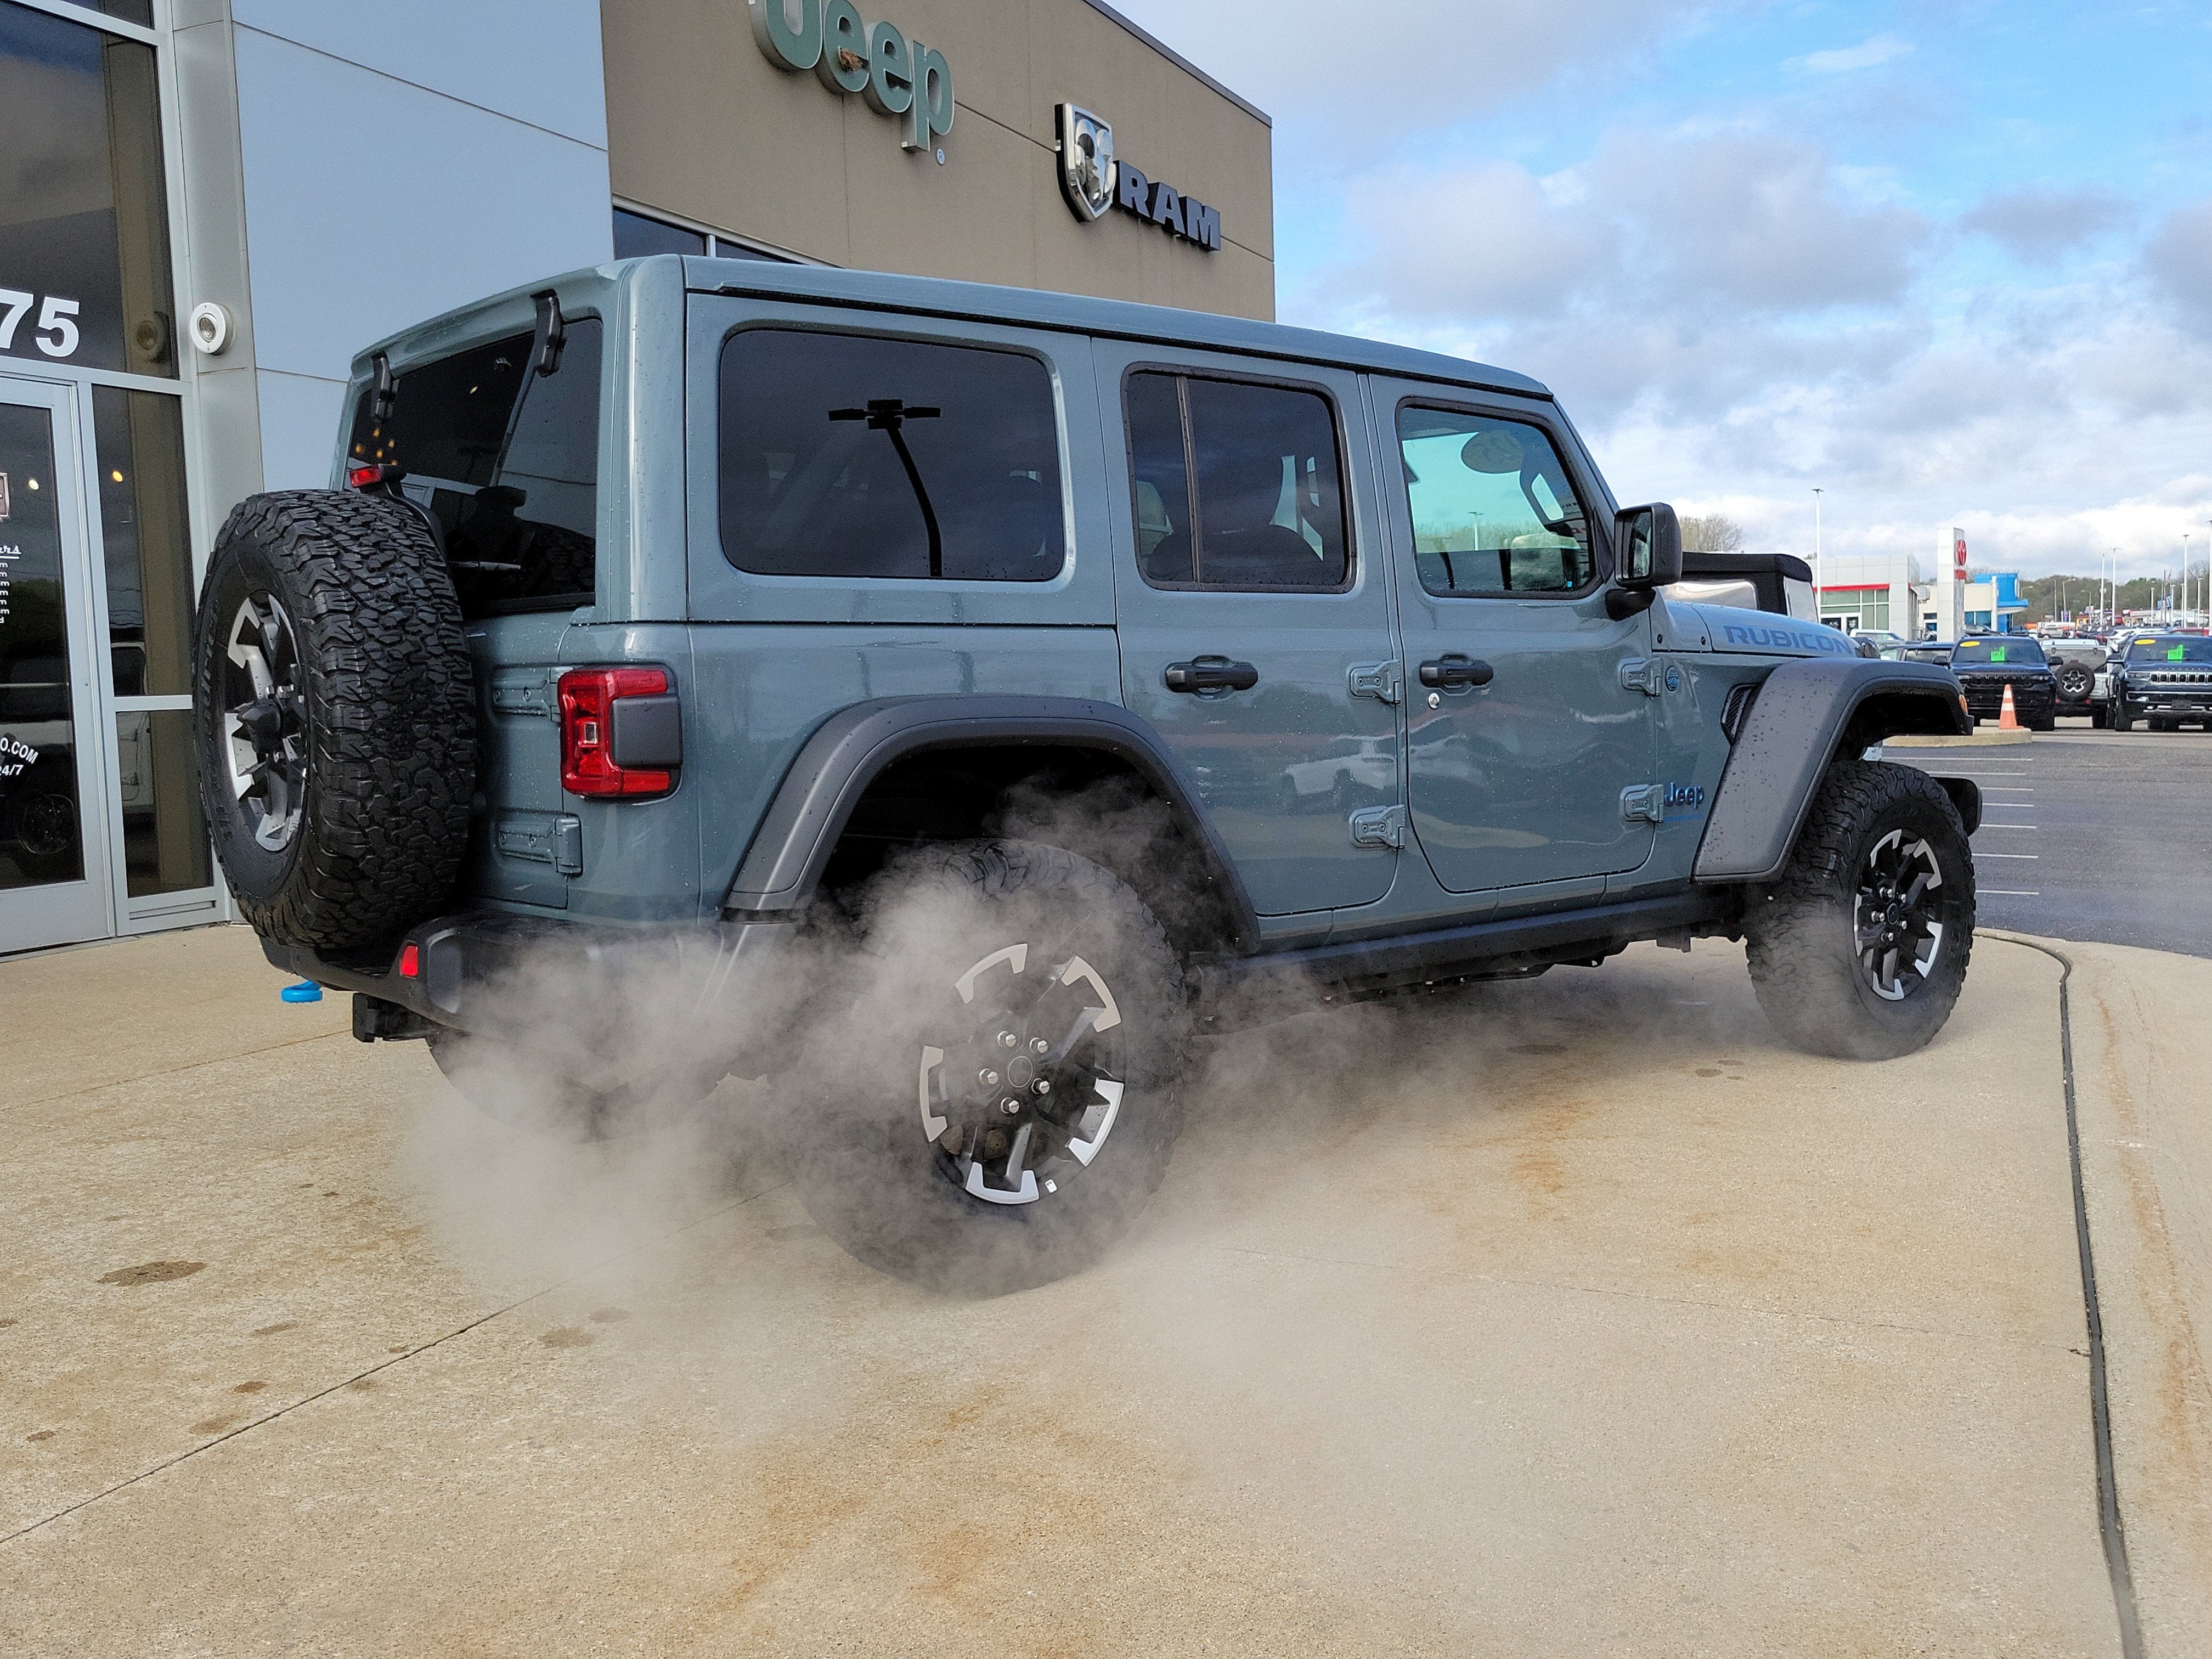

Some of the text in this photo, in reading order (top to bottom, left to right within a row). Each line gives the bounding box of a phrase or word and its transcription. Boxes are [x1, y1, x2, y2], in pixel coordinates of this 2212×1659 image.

[1114, 160, 1221, 251] RAM
[0, 289, 80, 357] 75
[1723, 625, 1853, 654] RUBICON
[0, 737, 38, 764] O.COM
[1663, 782, 1705, 809] Jeep
